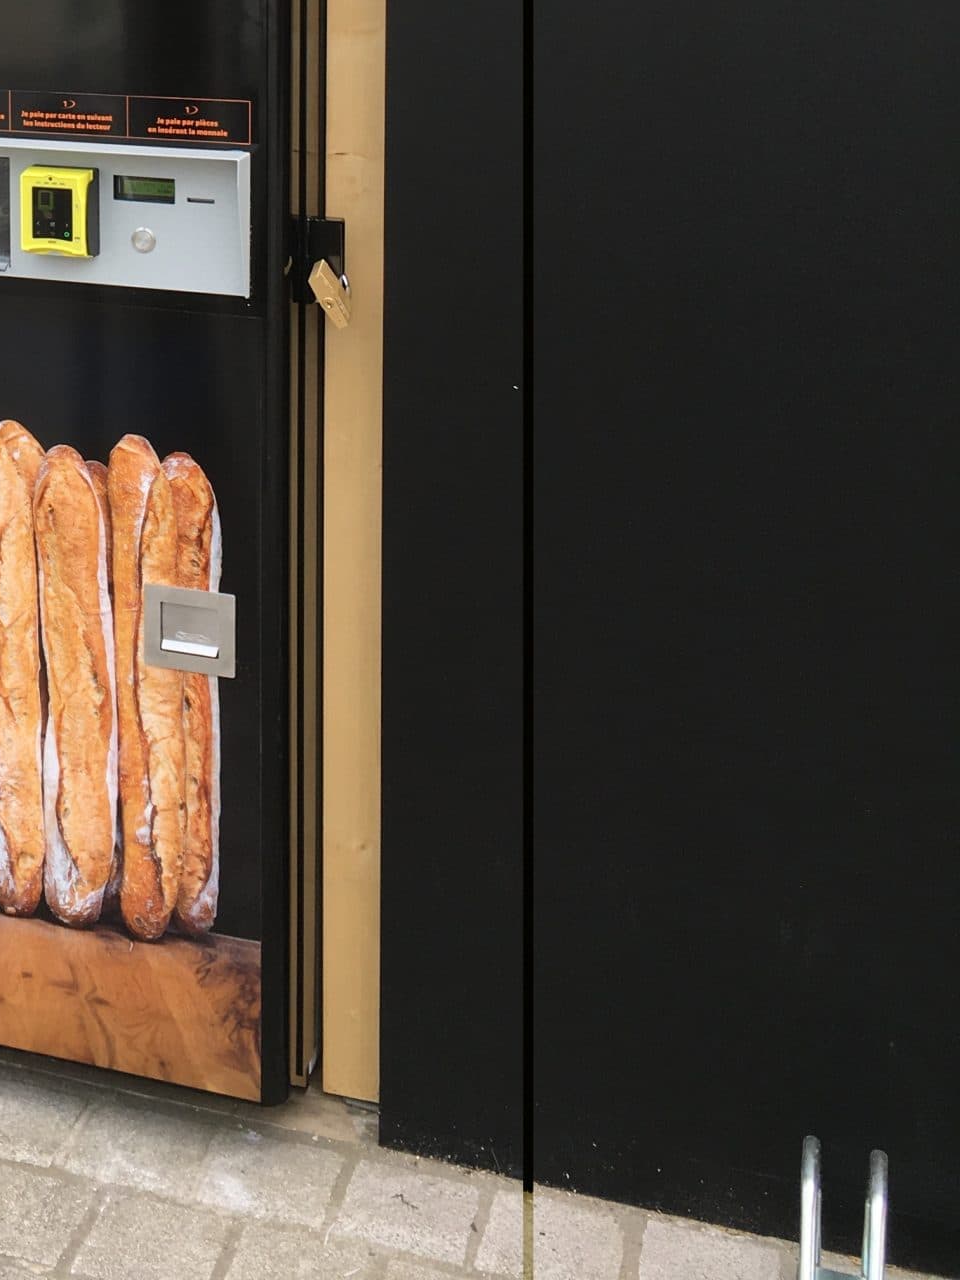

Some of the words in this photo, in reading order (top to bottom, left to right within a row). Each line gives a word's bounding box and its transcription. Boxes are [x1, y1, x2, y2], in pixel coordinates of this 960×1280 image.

[21, 110, 29, 118] Je
[29, 110, 44, 119] paie
[45, 112, 57, 120] par
[86, 114, 113, 122] suivant
[23, 119, 33, 127] les
[34, 120, 75, 129] instructions
[86, 122, 111, 130] lecteur
[156, 117, 164, 125] Je
[195, 119, 219, 127] pièces
[158, 126, 187, 135] insérant
[196, 128, 228, 137] monnaie
